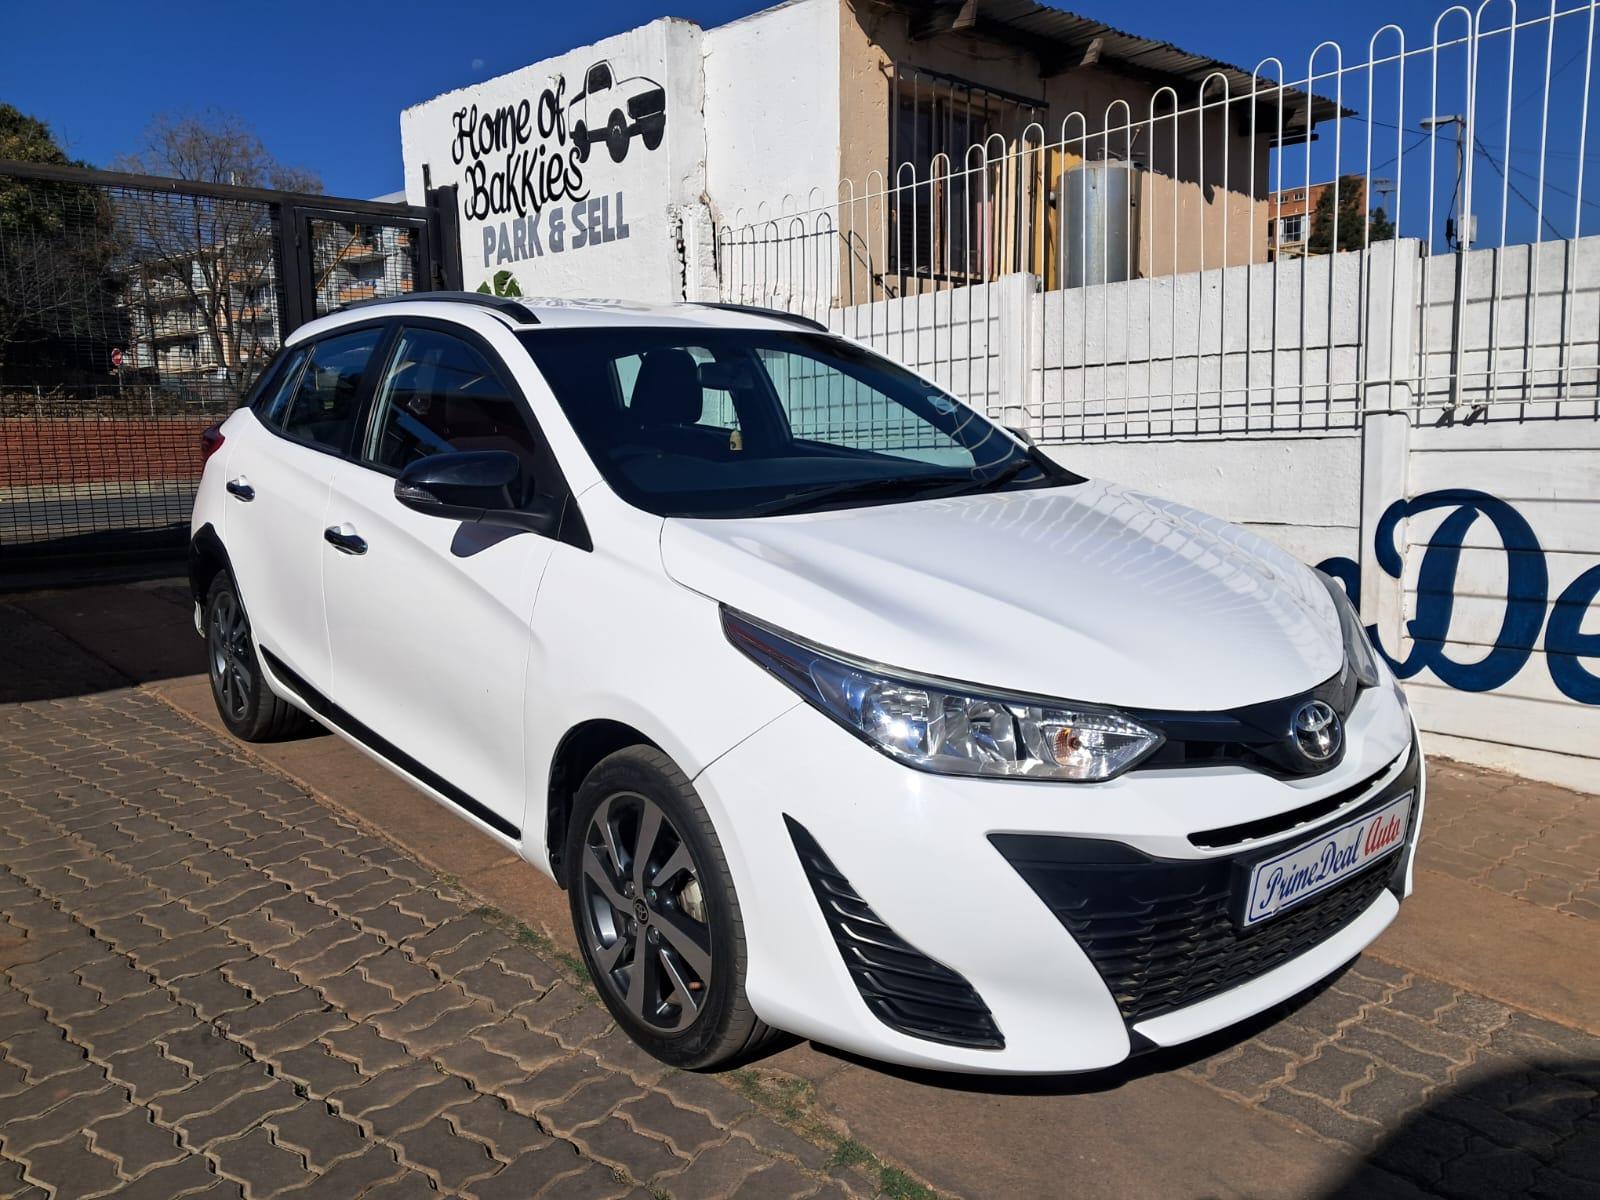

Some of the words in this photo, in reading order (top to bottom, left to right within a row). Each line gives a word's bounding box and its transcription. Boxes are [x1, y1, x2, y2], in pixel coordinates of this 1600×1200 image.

[452, 98, 532, 165] Home
[482, 211, 544, 268] PARK
[548, 206, 566, 253] &
[571, 191, 630, 249] SELL
[1364, 815, 1401, 857] Auto
